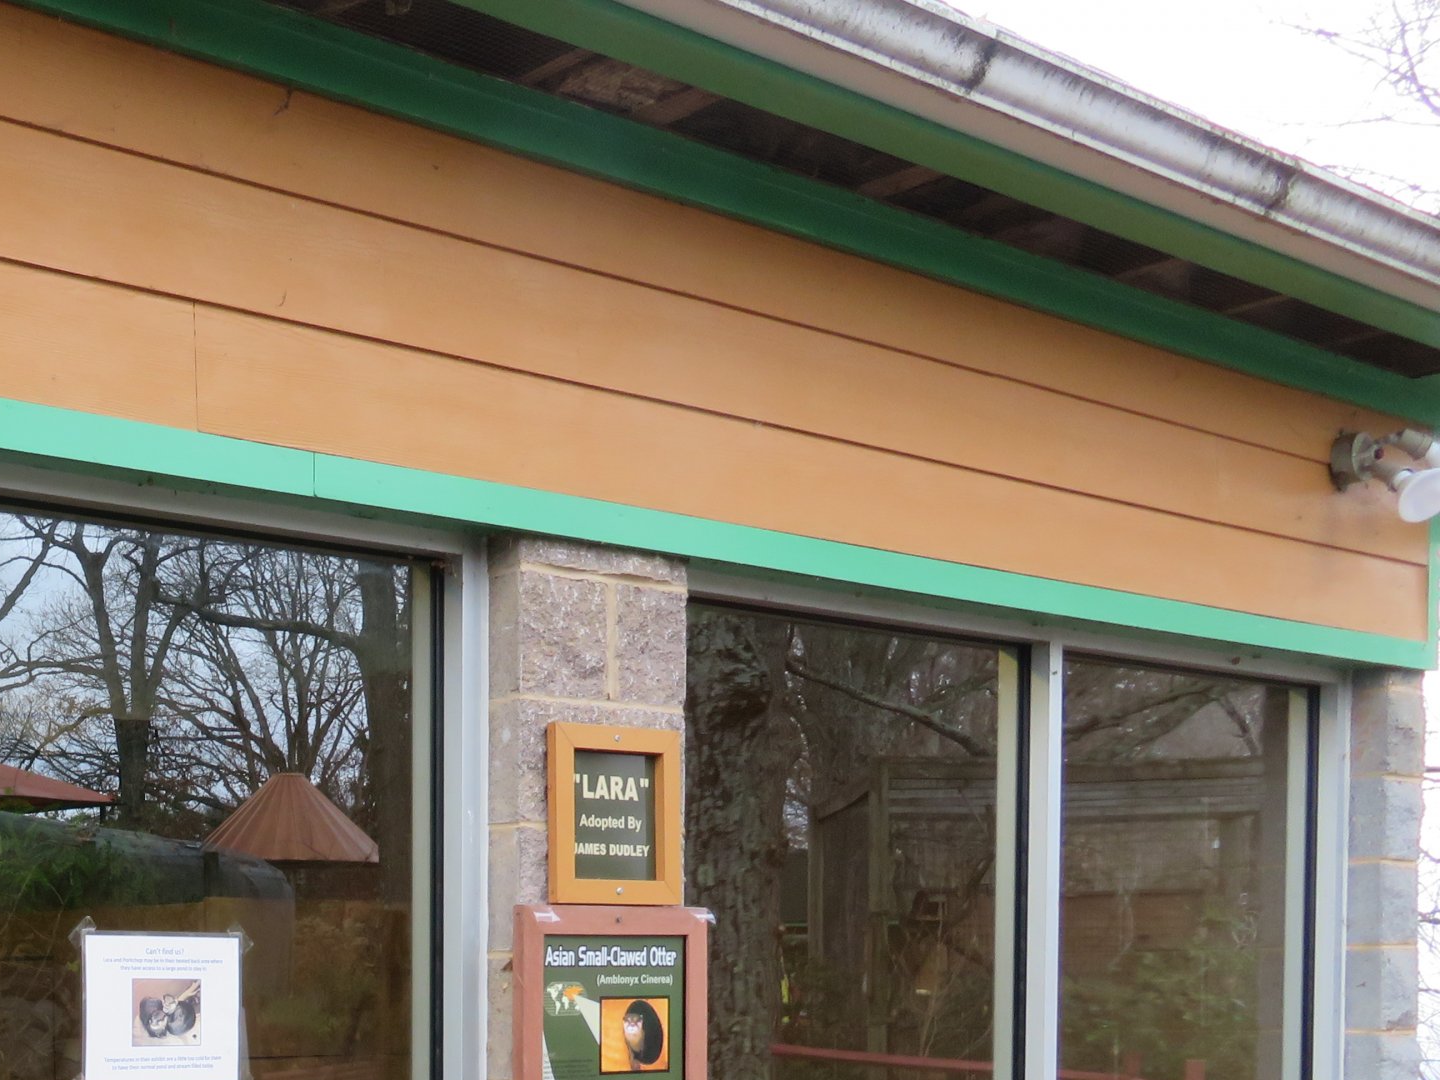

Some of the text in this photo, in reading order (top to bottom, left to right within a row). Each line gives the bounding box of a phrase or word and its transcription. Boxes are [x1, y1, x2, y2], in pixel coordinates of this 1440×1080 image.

[579, 813, 642, 833] Adopted By
[574, 842, 650, 858] JAMES DUDLEY
[145, 947, 185, 955] Can't find us?
[545, 945, 677, 967] Asian Small-Clawed Otter
[596, 974, 673, 987] (Amblonyx Cinerea)
